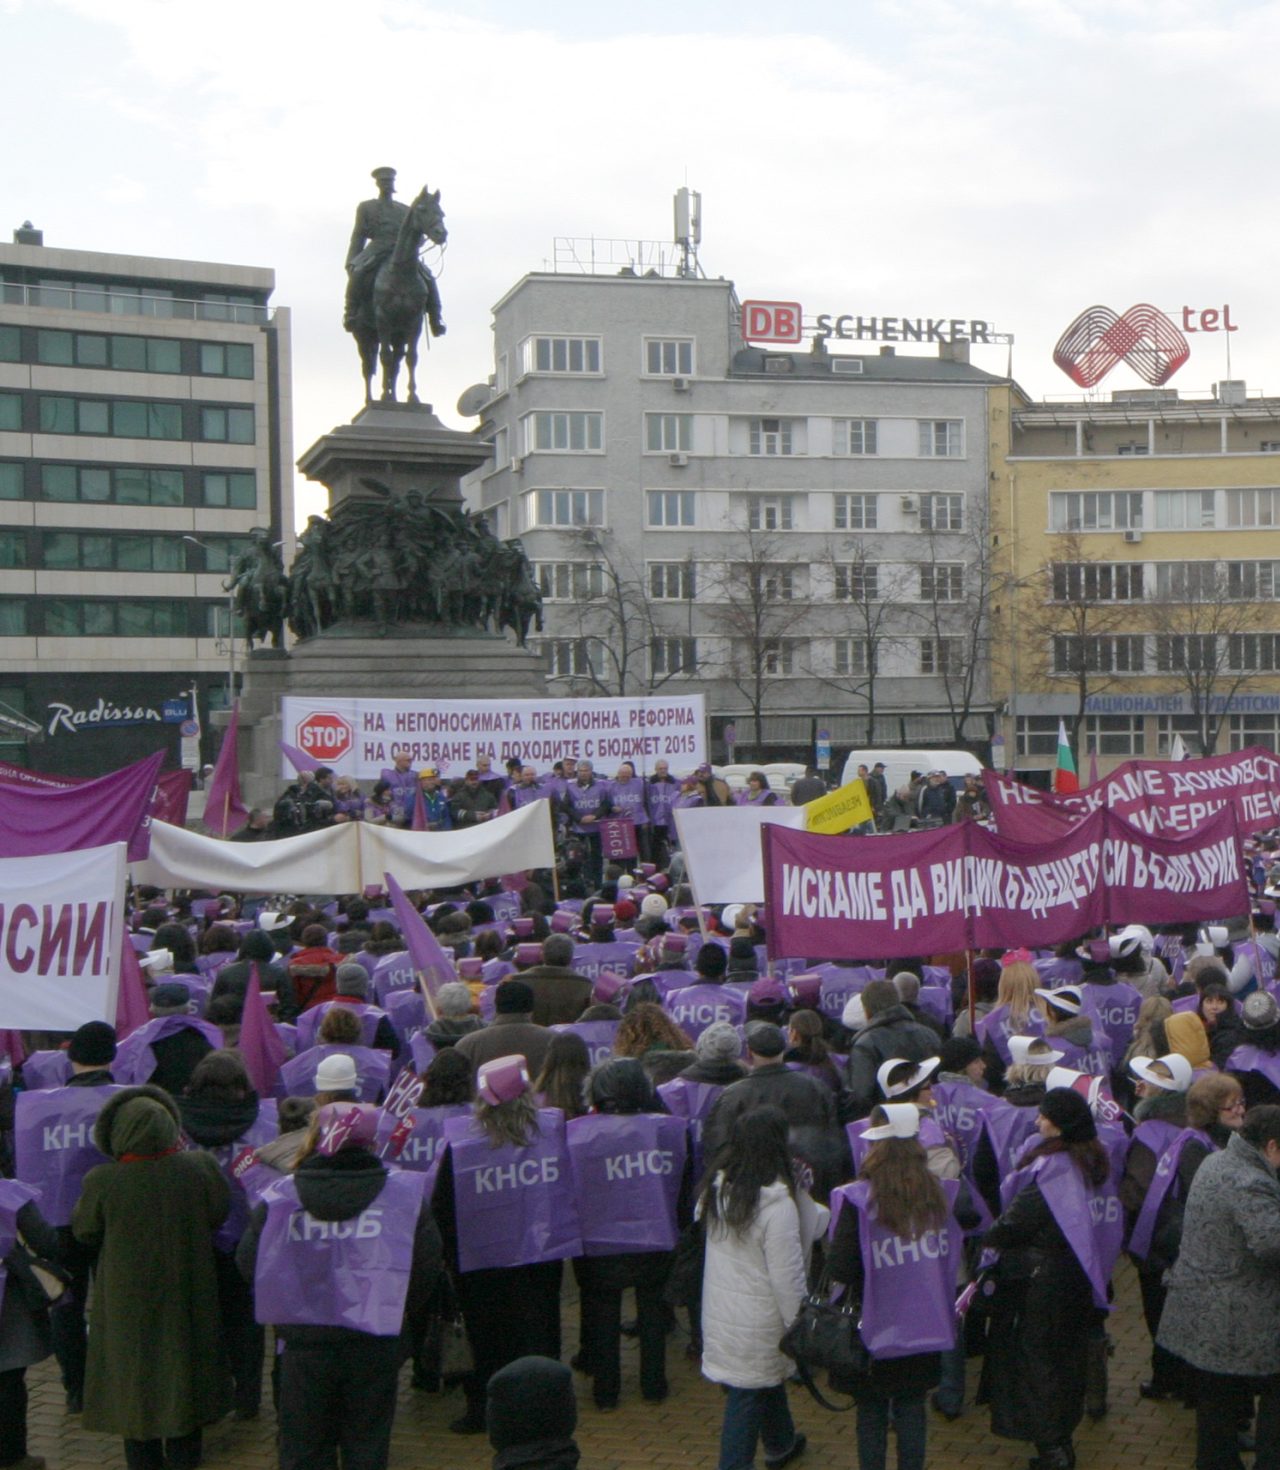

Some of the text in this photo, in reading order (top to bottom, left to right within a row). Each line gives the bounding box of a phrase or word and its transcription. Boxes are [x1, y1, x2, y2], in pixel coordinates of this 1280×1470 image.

[750, 307, 990, 343] DB SCHENKER
[1182, 304, 1239, 331] tel
[48, 698, 187, 735] Radisson BLU
[364, 707, 695, 732] НА НЕПОНОСИМАТА ПЕНСИОННА РЕФОРМА
[303, 726, 347, 747] STOP
[364, 742, 385, 761] НА
[476, 741, 496, 761] НА
[501, 739, 580, 763] ДОХОДИТЕ
[585, 739, 594, 757] С
[599, 736, 660, 758] БЮДЖЕТ
[665, 735, 696, 754] 2015
[998, 780, 1042, 805] НЕ
[608, 821, 624, 857] КНСБ
[782, 863, 888, 921] ИСКАМЕ
[891, 867, 928, 930] ДА
[930, 855, 1005, 919] ВИДИМ
[1005, 842, 1100, 919] БЪДЕЩЕТО
[1102, 838, 1127, 888] СИ
[0, 900, 114, 977] СИИ!
[388, 970, 417, 985] КН
[575, 961, 627, 980] КНСБ
[669, 1004, 729, 1025] КНСБ
[822, 992, 856, 1010] КН
[1096, 1006, 1136, 1026] НСБ
[1077, 1051, 1103, 1075] КН
[933, 1103, 975, 1131] НСБ
[475, 1157, 560, 1194] КНСБ
[605, 1150, 673, 1181] КНСБ
[1088, 1197, 1120, 1223] СБ
[288, 1209, 383, 1242] КНСБ
[872, 1229, 949, 1269] КНСБ
